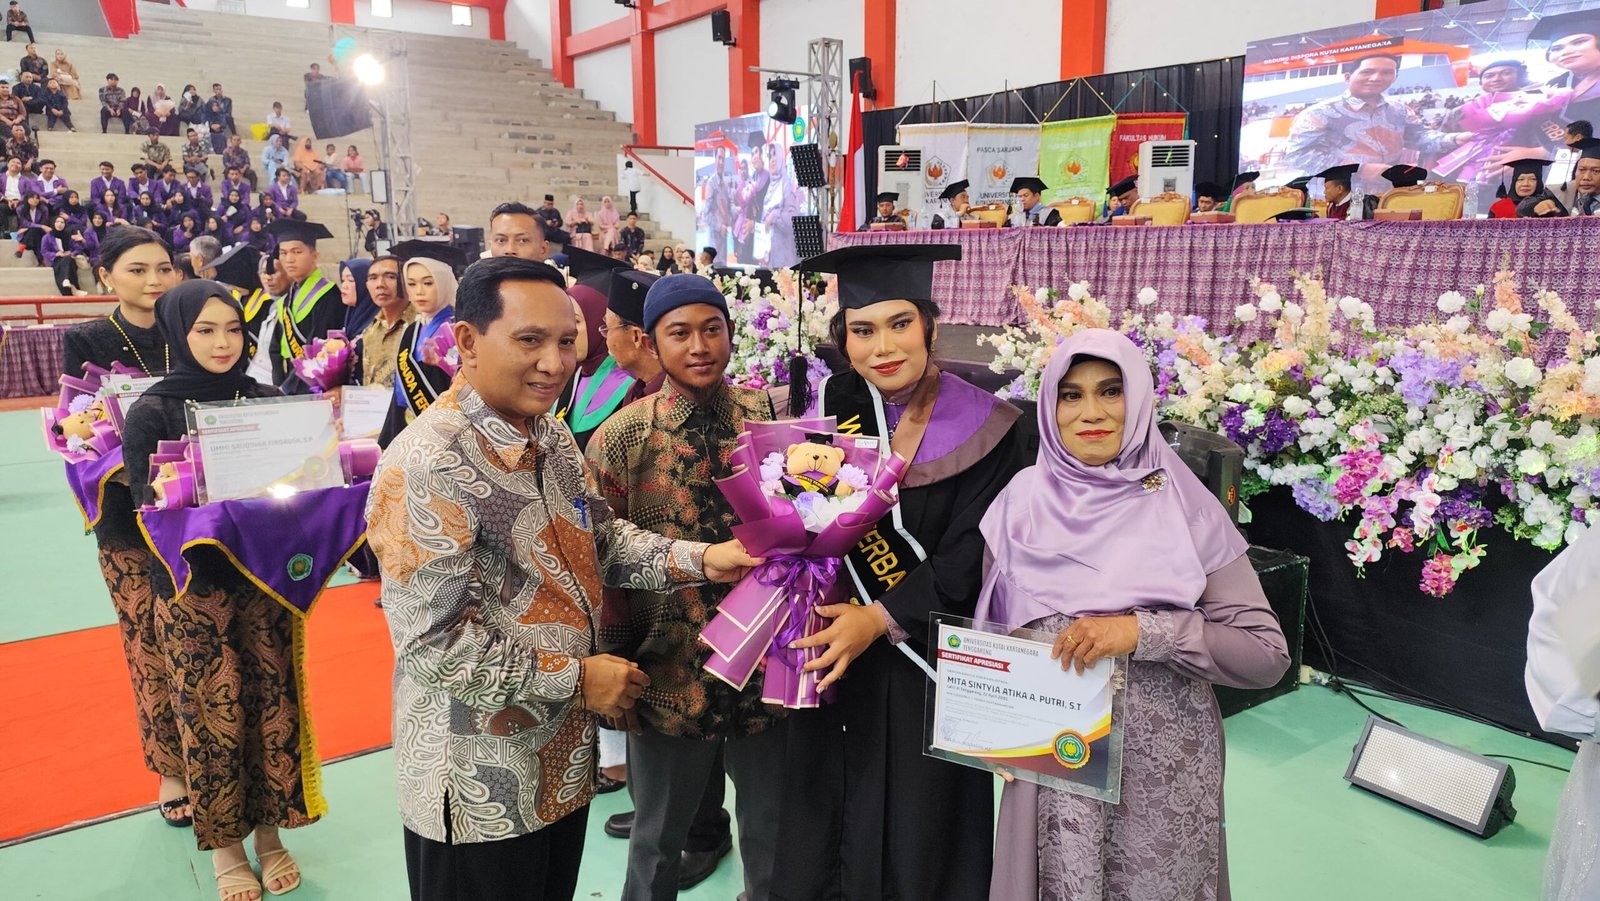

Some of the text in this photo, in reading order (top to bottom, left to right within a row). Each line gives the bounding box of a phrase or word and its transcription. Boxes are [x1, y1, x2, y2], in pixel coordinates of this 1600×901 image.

[1290, 51, 1318, 61] DISPORA
[1319, 48, 1339, 56] KUTAI
[1340, 40, 1392, 53] KARTANEGARA
[1119, 134, 1147, 142] FAKULTAS
[858, 526, 907, 592] ERBA
[963, 637, 1039, 657] UNIVERSITAS KUTAI KARTANEGARA
[963, 645, 992, 656] TENGGARONG
[941, 651, 1004, 669] SERTIFIKAT APRESIASI
[947, 676, 967, 687] MITA
[968, 680, 1000, 694] SINTYIA
[1002, 688, 1028, 700] ATIKA
[1069, 702, 1082, 711] S.T
